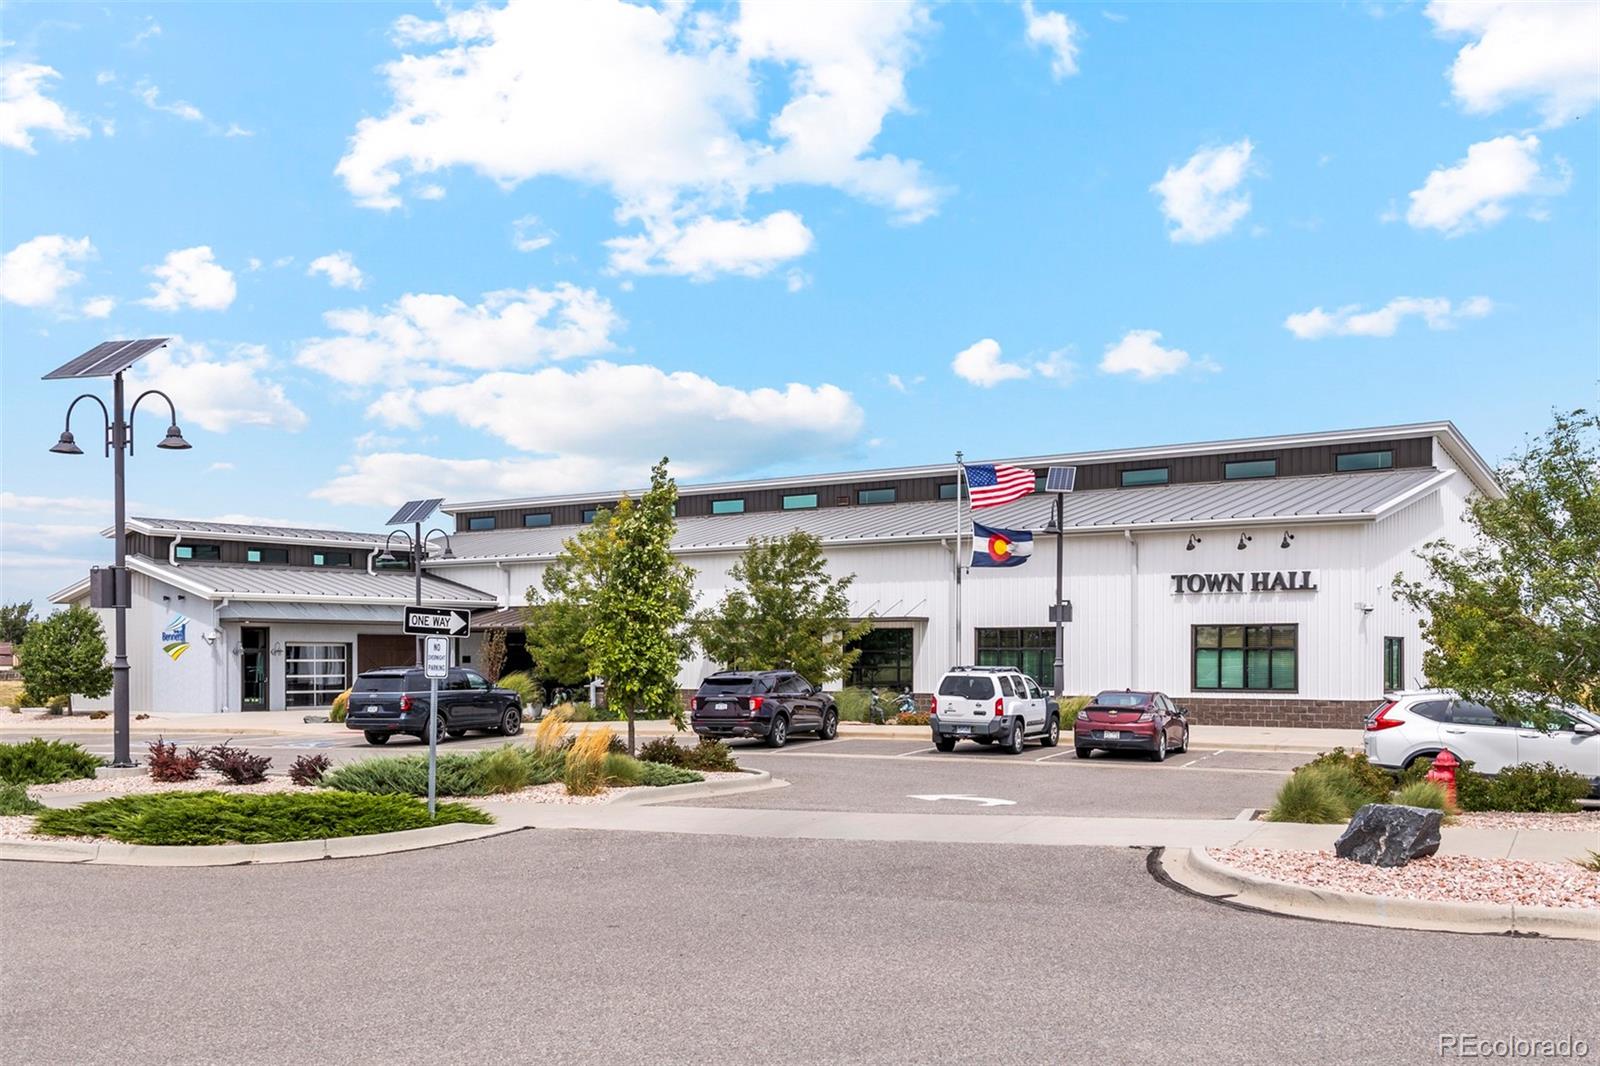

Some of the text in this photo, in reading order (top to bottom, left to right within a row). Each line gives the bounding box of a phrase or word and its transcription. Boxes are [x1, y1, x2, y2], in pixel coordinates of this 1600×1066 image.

[1171, 571, 1318, 593] TOWN HALL
[411, 614, 450, 628] ONE WAY
[433, 643, 441, 652] NO
[428, 664, 446, 672] PARKING
